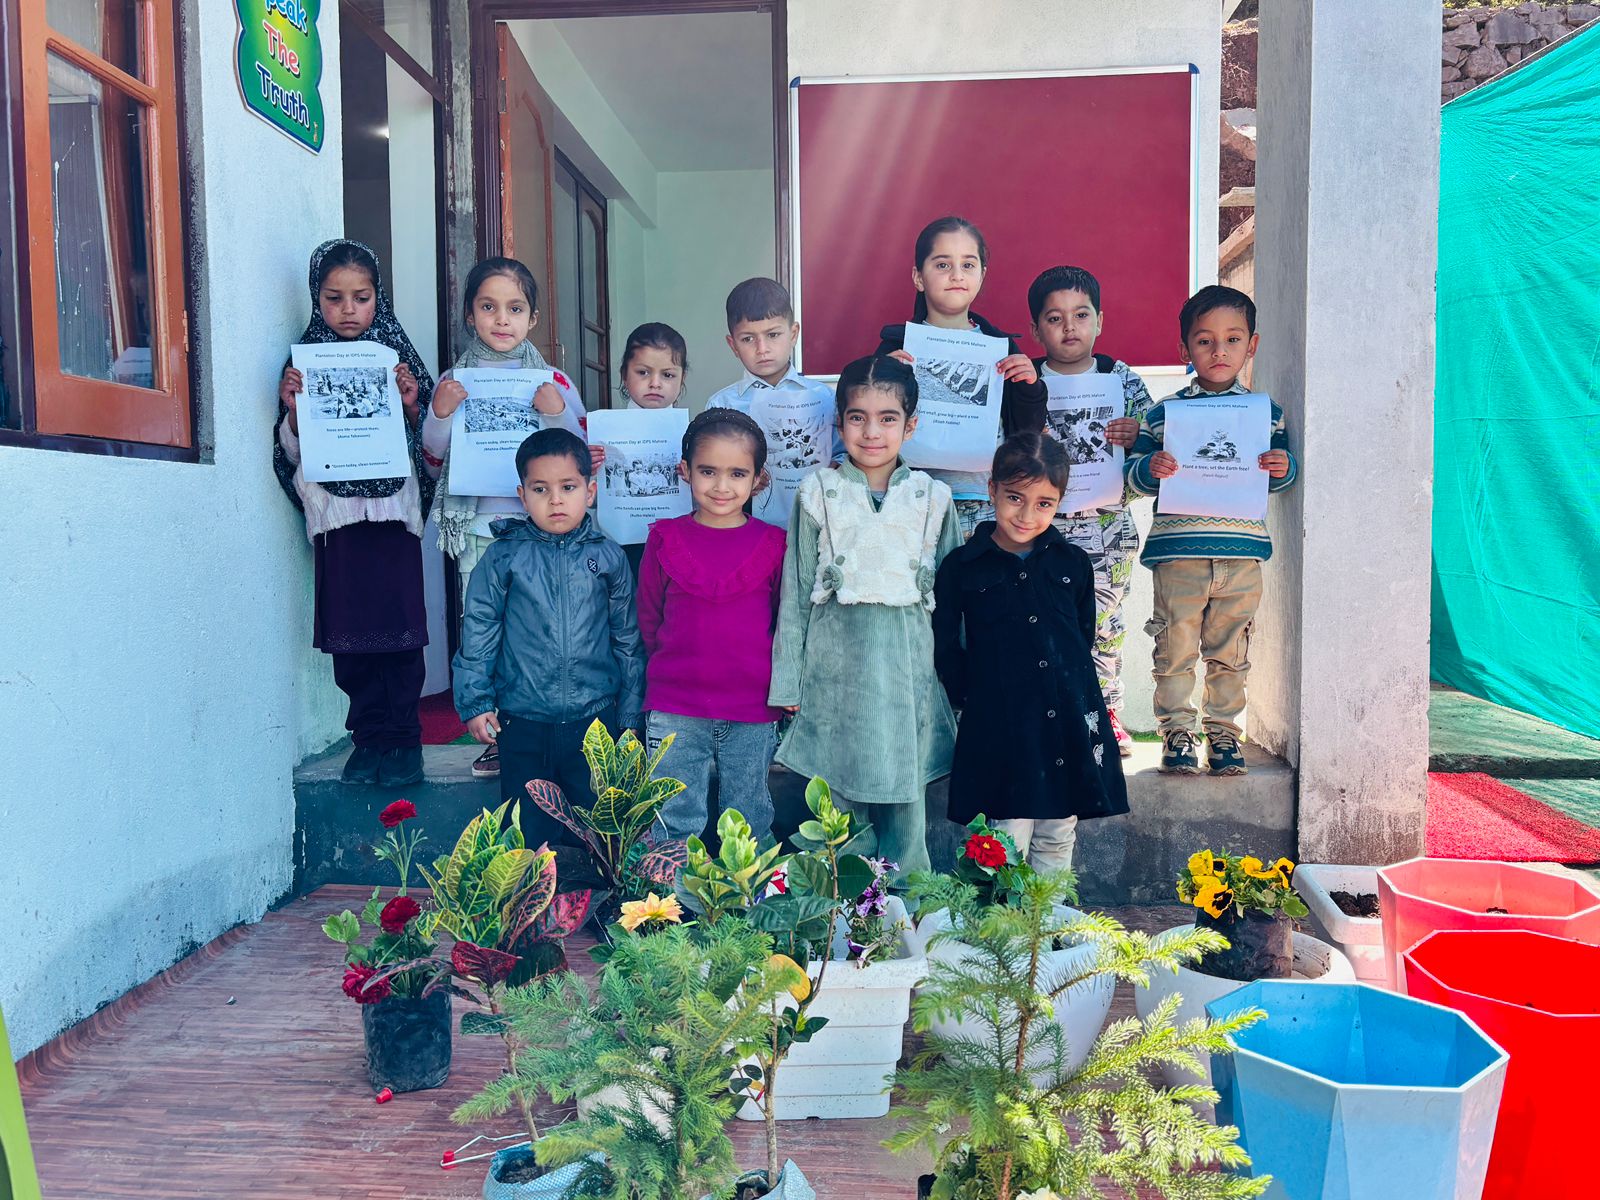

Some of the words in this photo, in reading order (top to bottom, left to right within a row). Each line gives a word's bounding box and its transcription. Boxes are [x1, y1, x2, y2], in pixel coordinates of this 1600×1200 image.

[262, 19, 299, 75] The
[255, 60, 309, 129] Truth
[1182, 463, 1194, 471] Plant
